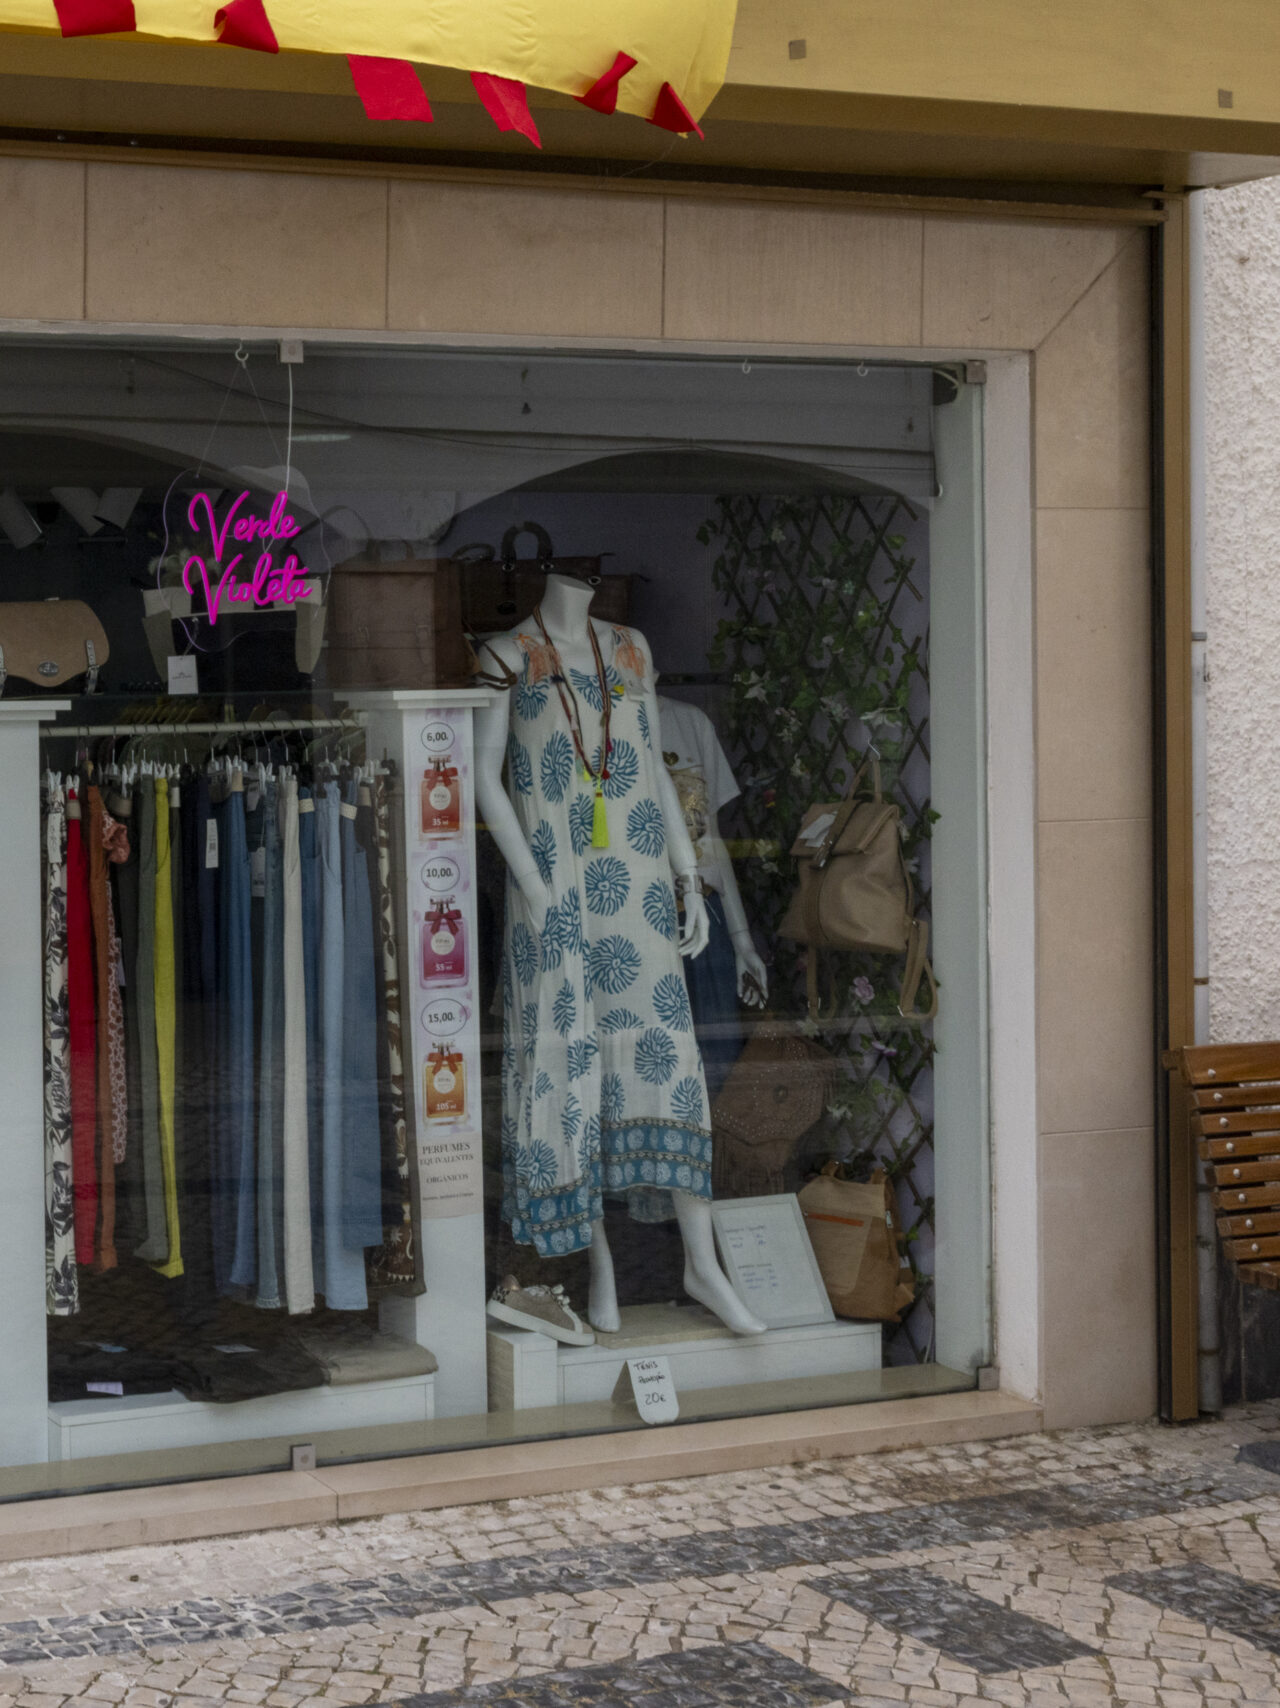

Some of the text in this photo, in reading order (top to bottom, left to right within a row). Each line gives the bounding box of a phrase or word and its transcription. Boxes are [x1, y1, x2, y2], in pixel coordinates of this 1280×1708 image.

[188, 490, 301, 562] Verde
[183, 553, 312, 626] Violeta
[422, 1142, 471, 1155] PERFUMES
[645, 1392, 667, 1405] 20€
